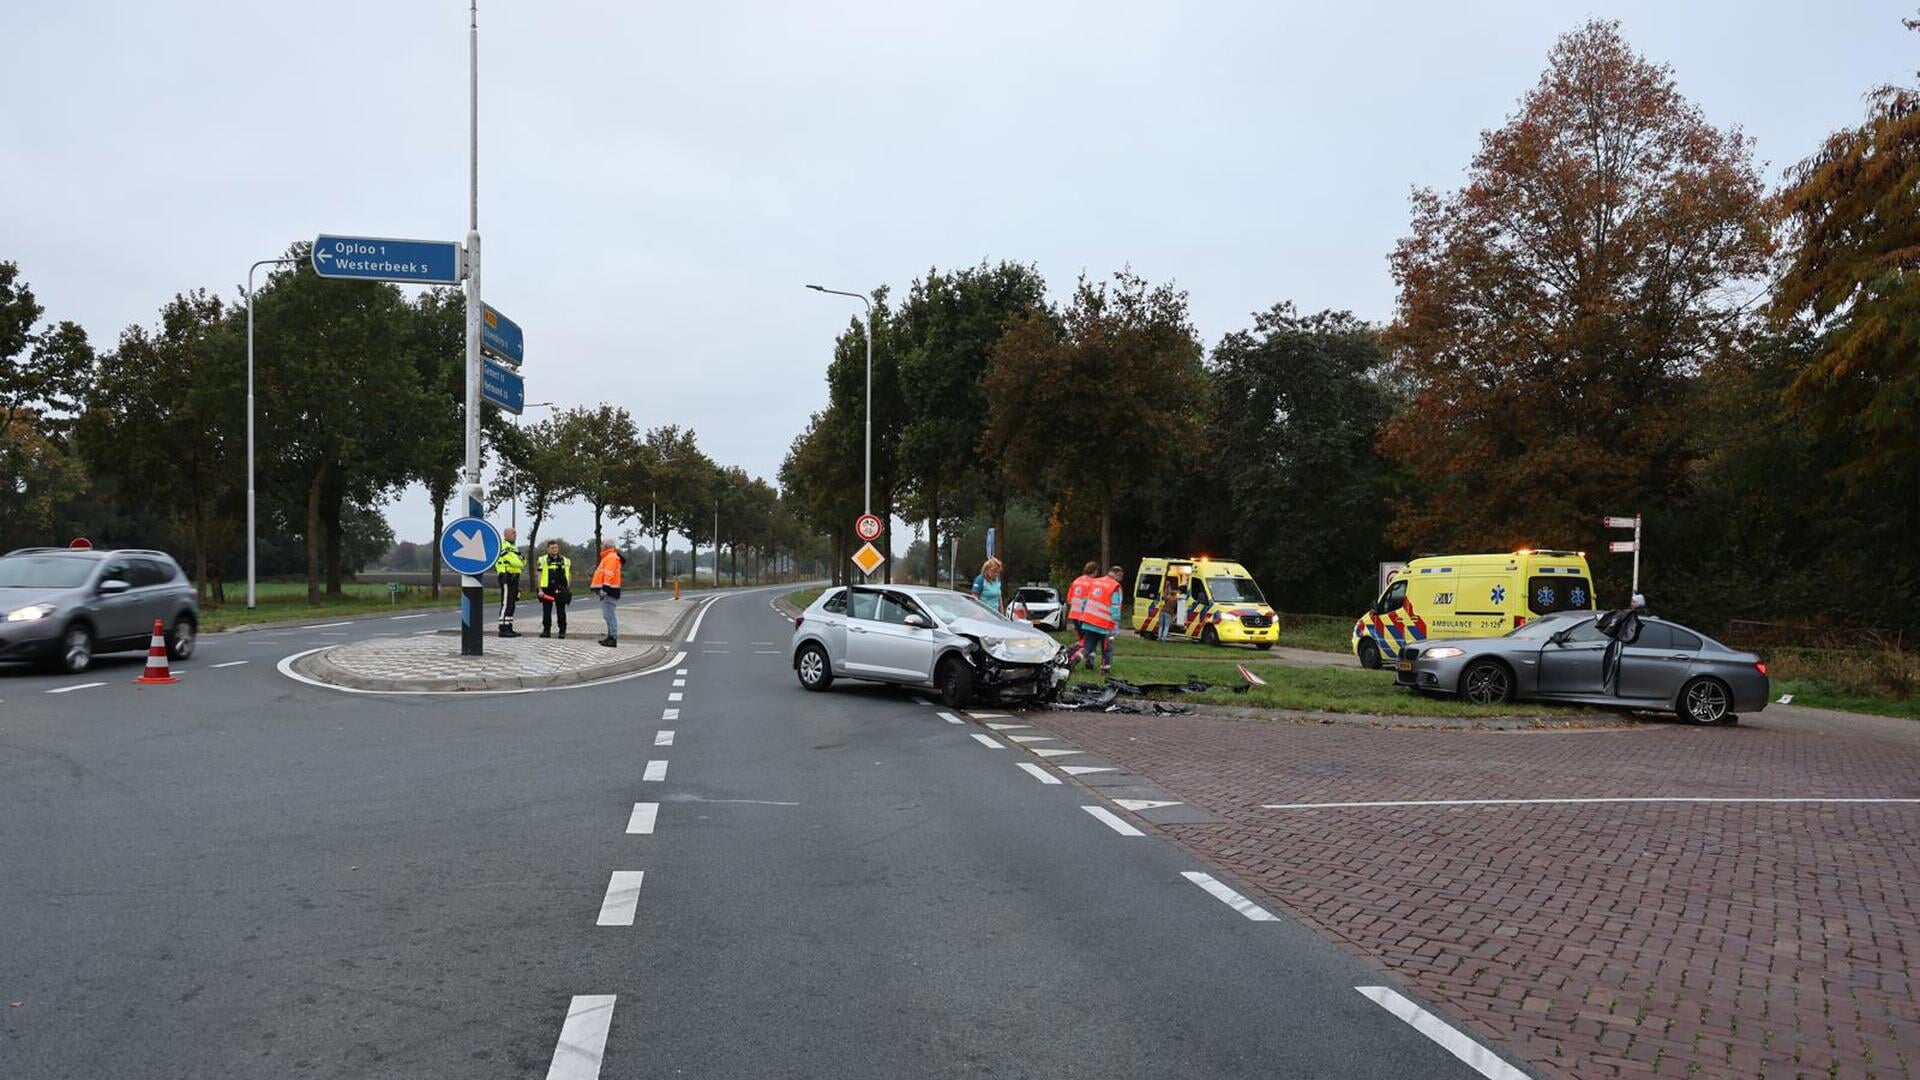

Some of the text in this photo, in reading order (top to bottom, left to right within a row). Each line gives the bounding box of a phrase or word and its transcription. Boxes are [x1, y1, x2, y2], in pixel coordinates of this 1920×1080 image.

[335, 242, 385, 255] Oploo 1
[335, 258, 428, 273] Westerbeek 5
[1432, 620, 1472, 628] AMBULANCE
